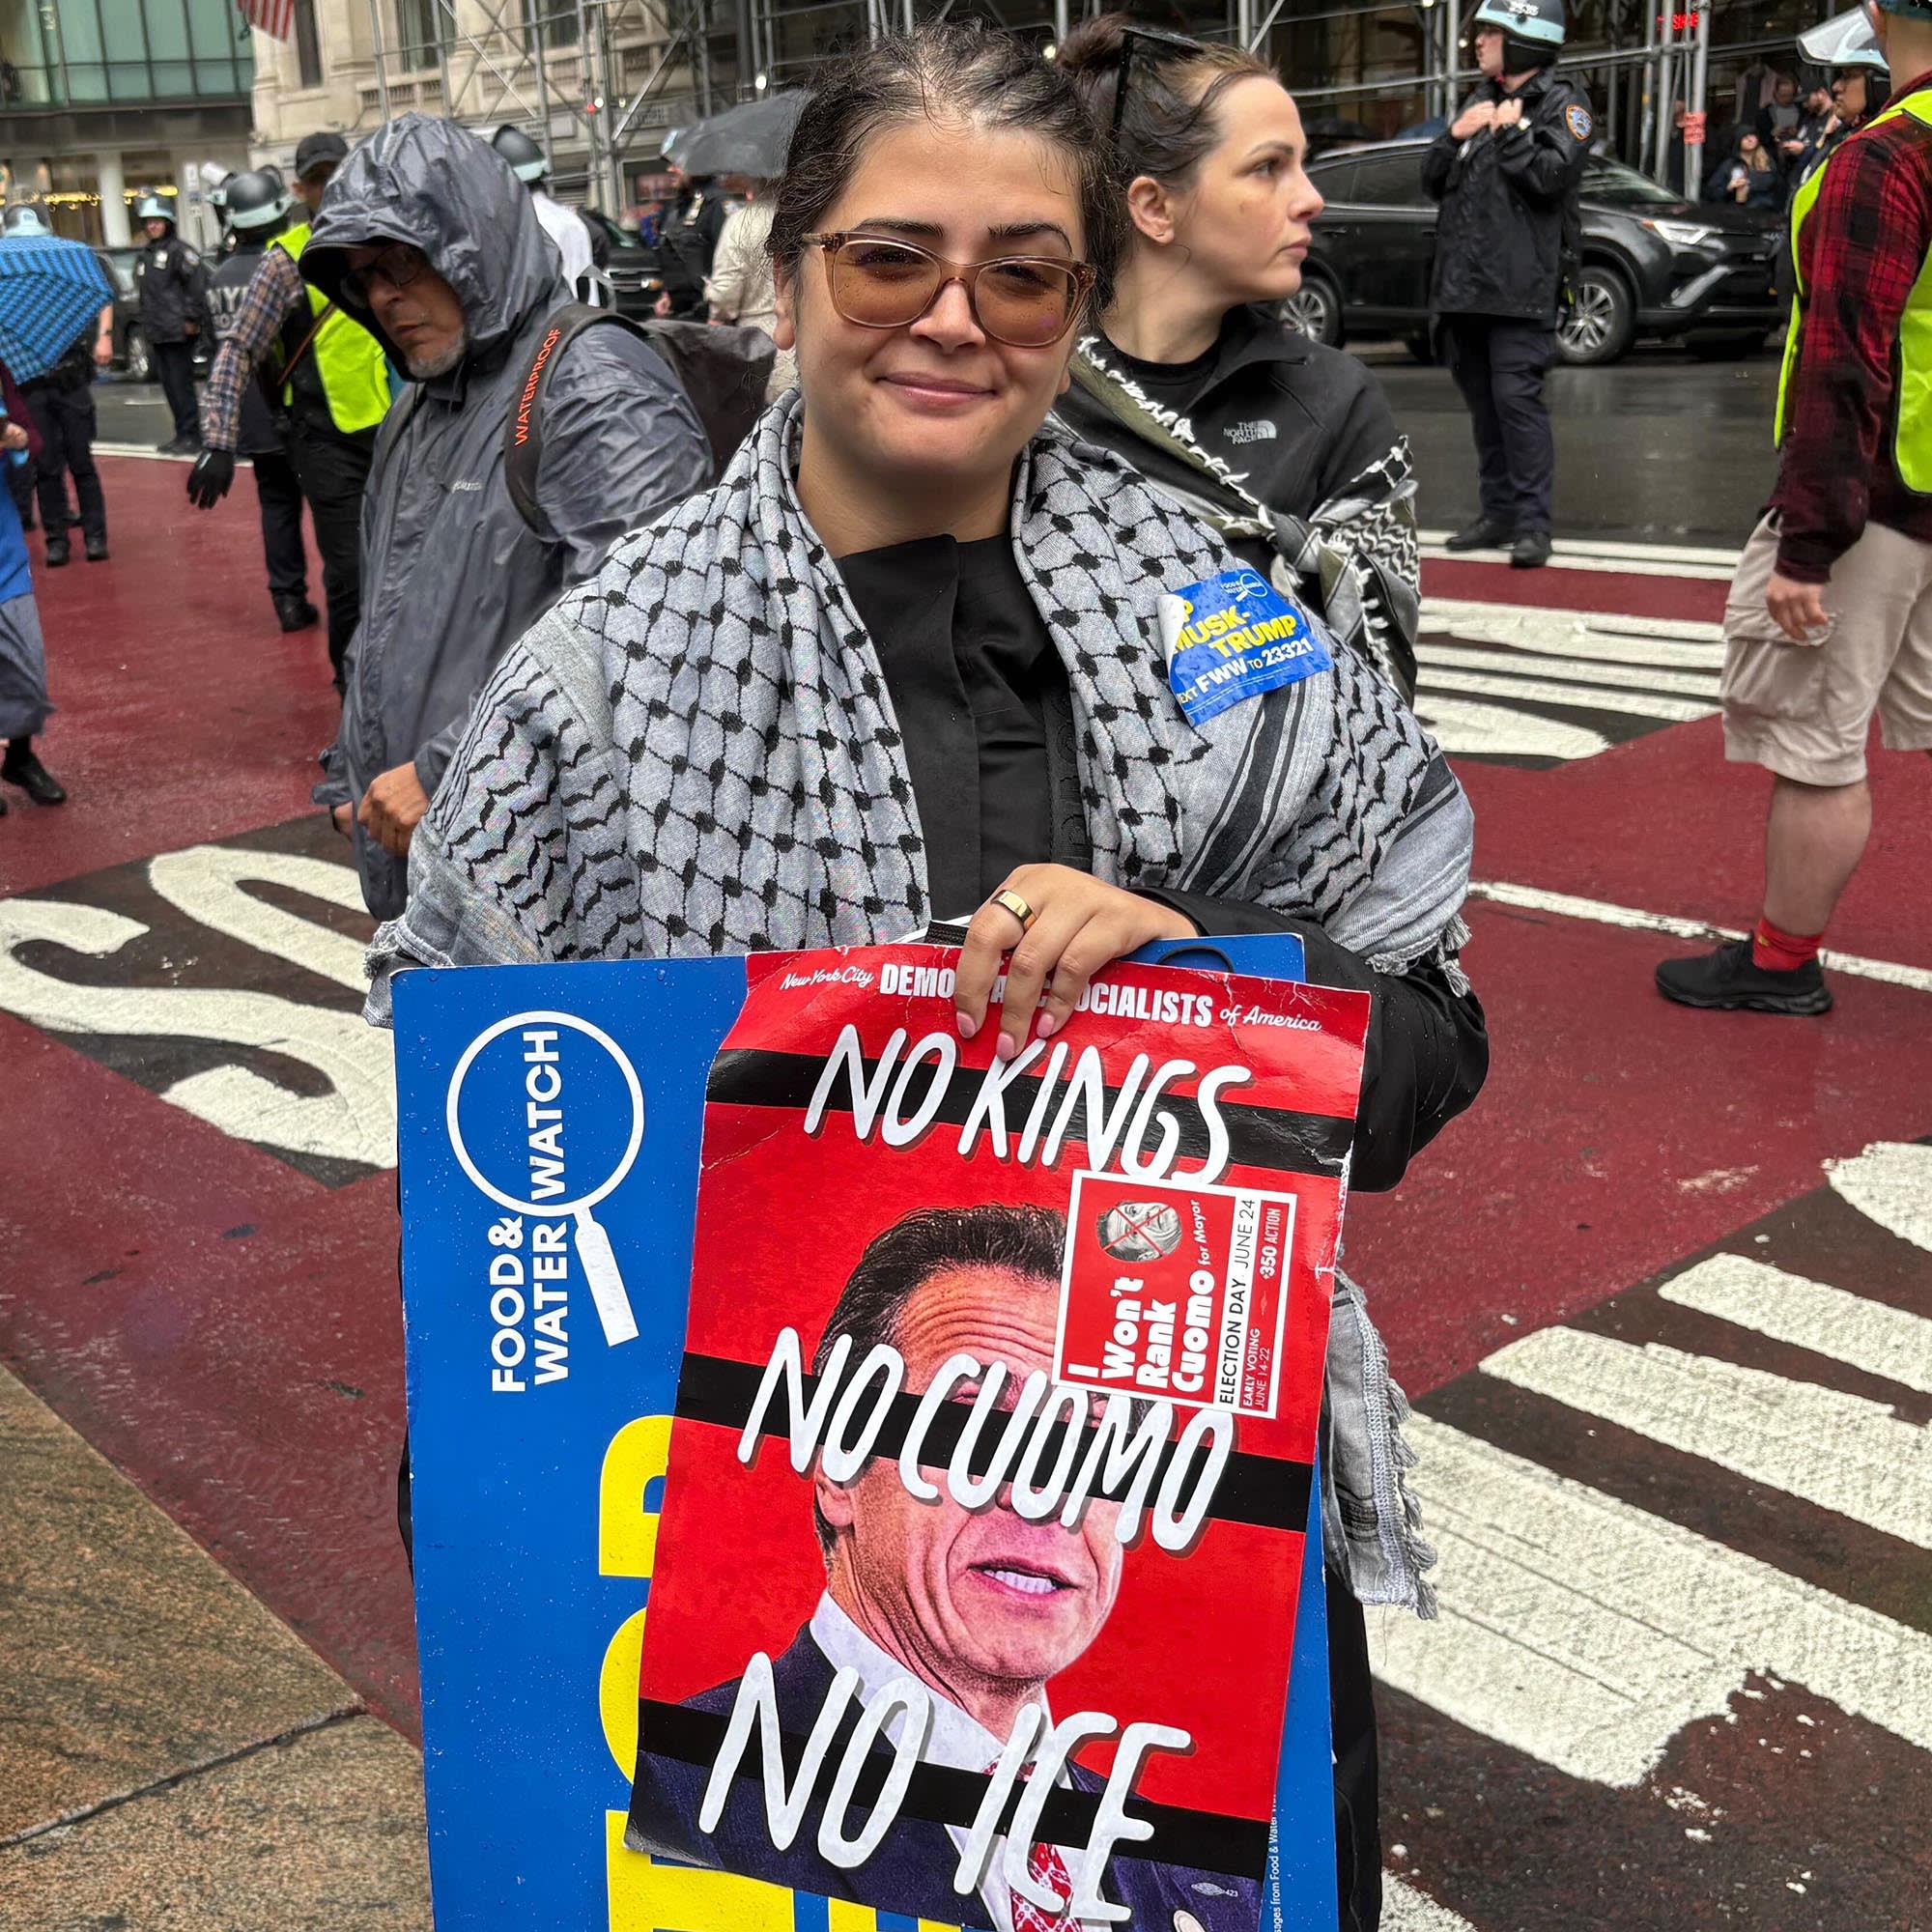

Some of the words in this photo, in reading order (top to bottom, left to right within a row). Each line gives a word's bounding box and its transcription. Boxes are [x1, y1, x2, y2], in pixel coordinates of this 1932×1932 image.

[206, 286, 250, 314] NY
[514, 327, 561, 446] WATERPROOF
[1208, 614, 1296, 658] TRUMP
[1195, 658, 1248, 694] FWW
[1247, 659, 1264, 670] TO
[1262, 638, 1314, 667] 23321
[780, 974, 810, 989] New
[810, 969, 841, 985] York
[841, 966, 873, 988] City
[1072, 982, 1212, 1028] OCIALISTS
[1219, 1004, 1239, 1026] of
[1242, 1006, 1321, 1032] America
[523, 1030, 567, 1202] WATCH
[803, 1024, 956, 1147] NO
[957, 1038, 1251, 1186] KINGS
[1189, 1199, 1208, 1243] Mayor
[1239, 1199, 1256, 1221] 24
[1264, 1208, 1282, 1244] ACTION
[488, 1215, 525, 1250] &
[1235, 1224, 1252, 1268] JUNE
[1198, 1247, 1211, 1265] for
[532, 1221, 570, 1385] WATER
[1230, 1278, 1246, 1317] DAY
[489, 1253, 526, 1391] FOOD
[1136, 1298, 1177, 1389] Rank
[1172, 1270, 1215, 1392] Cuomo
[1067, 1363, 1099, 1378] I
[1219, 1321, 1241, 1405] ELECTION
[1247, 1328, 1261, 1372] VOTING
[1242, 1377, 1255, 1406] EARLY
[1255, 1381, 1266, 1408] JUNE
[737, 1326, 905, 1483] NO
[899, 1352, 1235, 1551] CUOMO
[698, 1651, 930, 1868] NO
[953, 1703, 1192, 1922] ICE
[1267, 1845, 1279, 1854] &
[1268, 1817, 1278, 1844] Wate
[1268, 1855, 1280, 1880] Food
[1270, 1882, 1281, 1905] from
